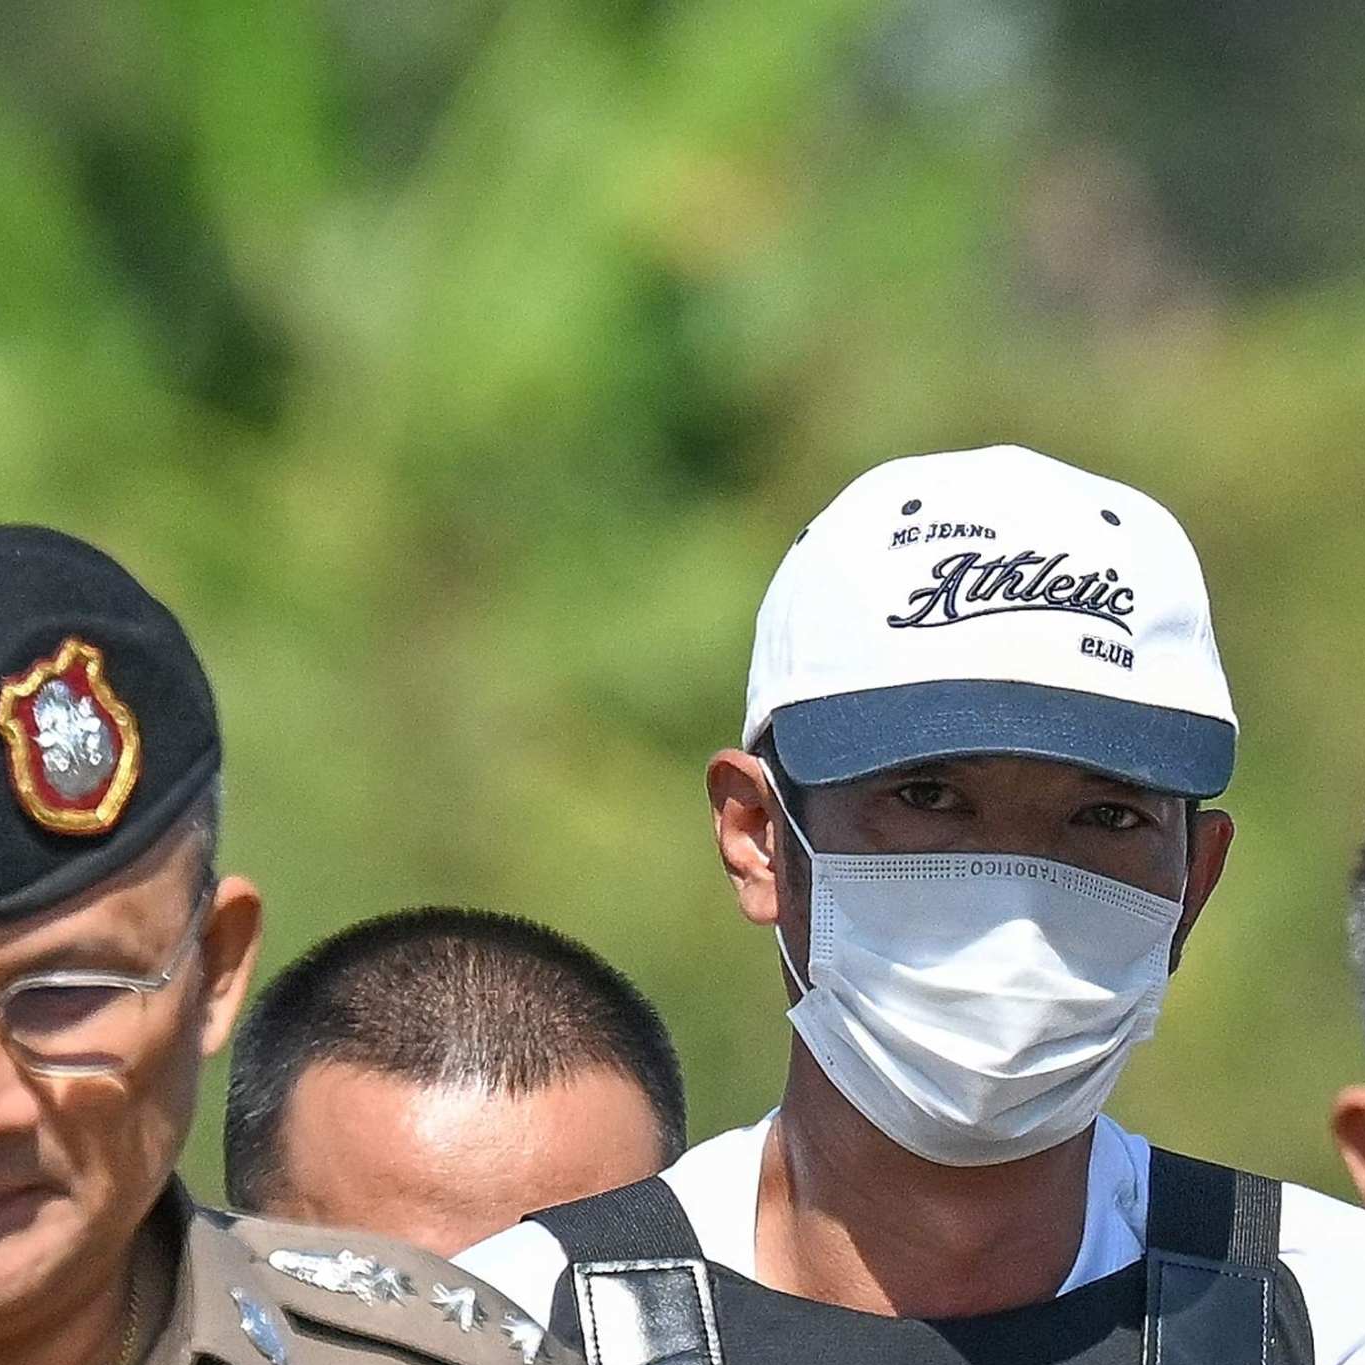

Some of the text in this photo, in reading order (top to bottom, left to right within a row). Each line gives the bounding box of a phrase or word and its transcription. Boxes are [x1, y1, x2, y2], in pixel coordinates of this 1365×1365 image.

[891, 526, 922, 546] MC
[887, 550, 1134, 628] Athletic
[1079, 636, 1134, 668] CLUB
